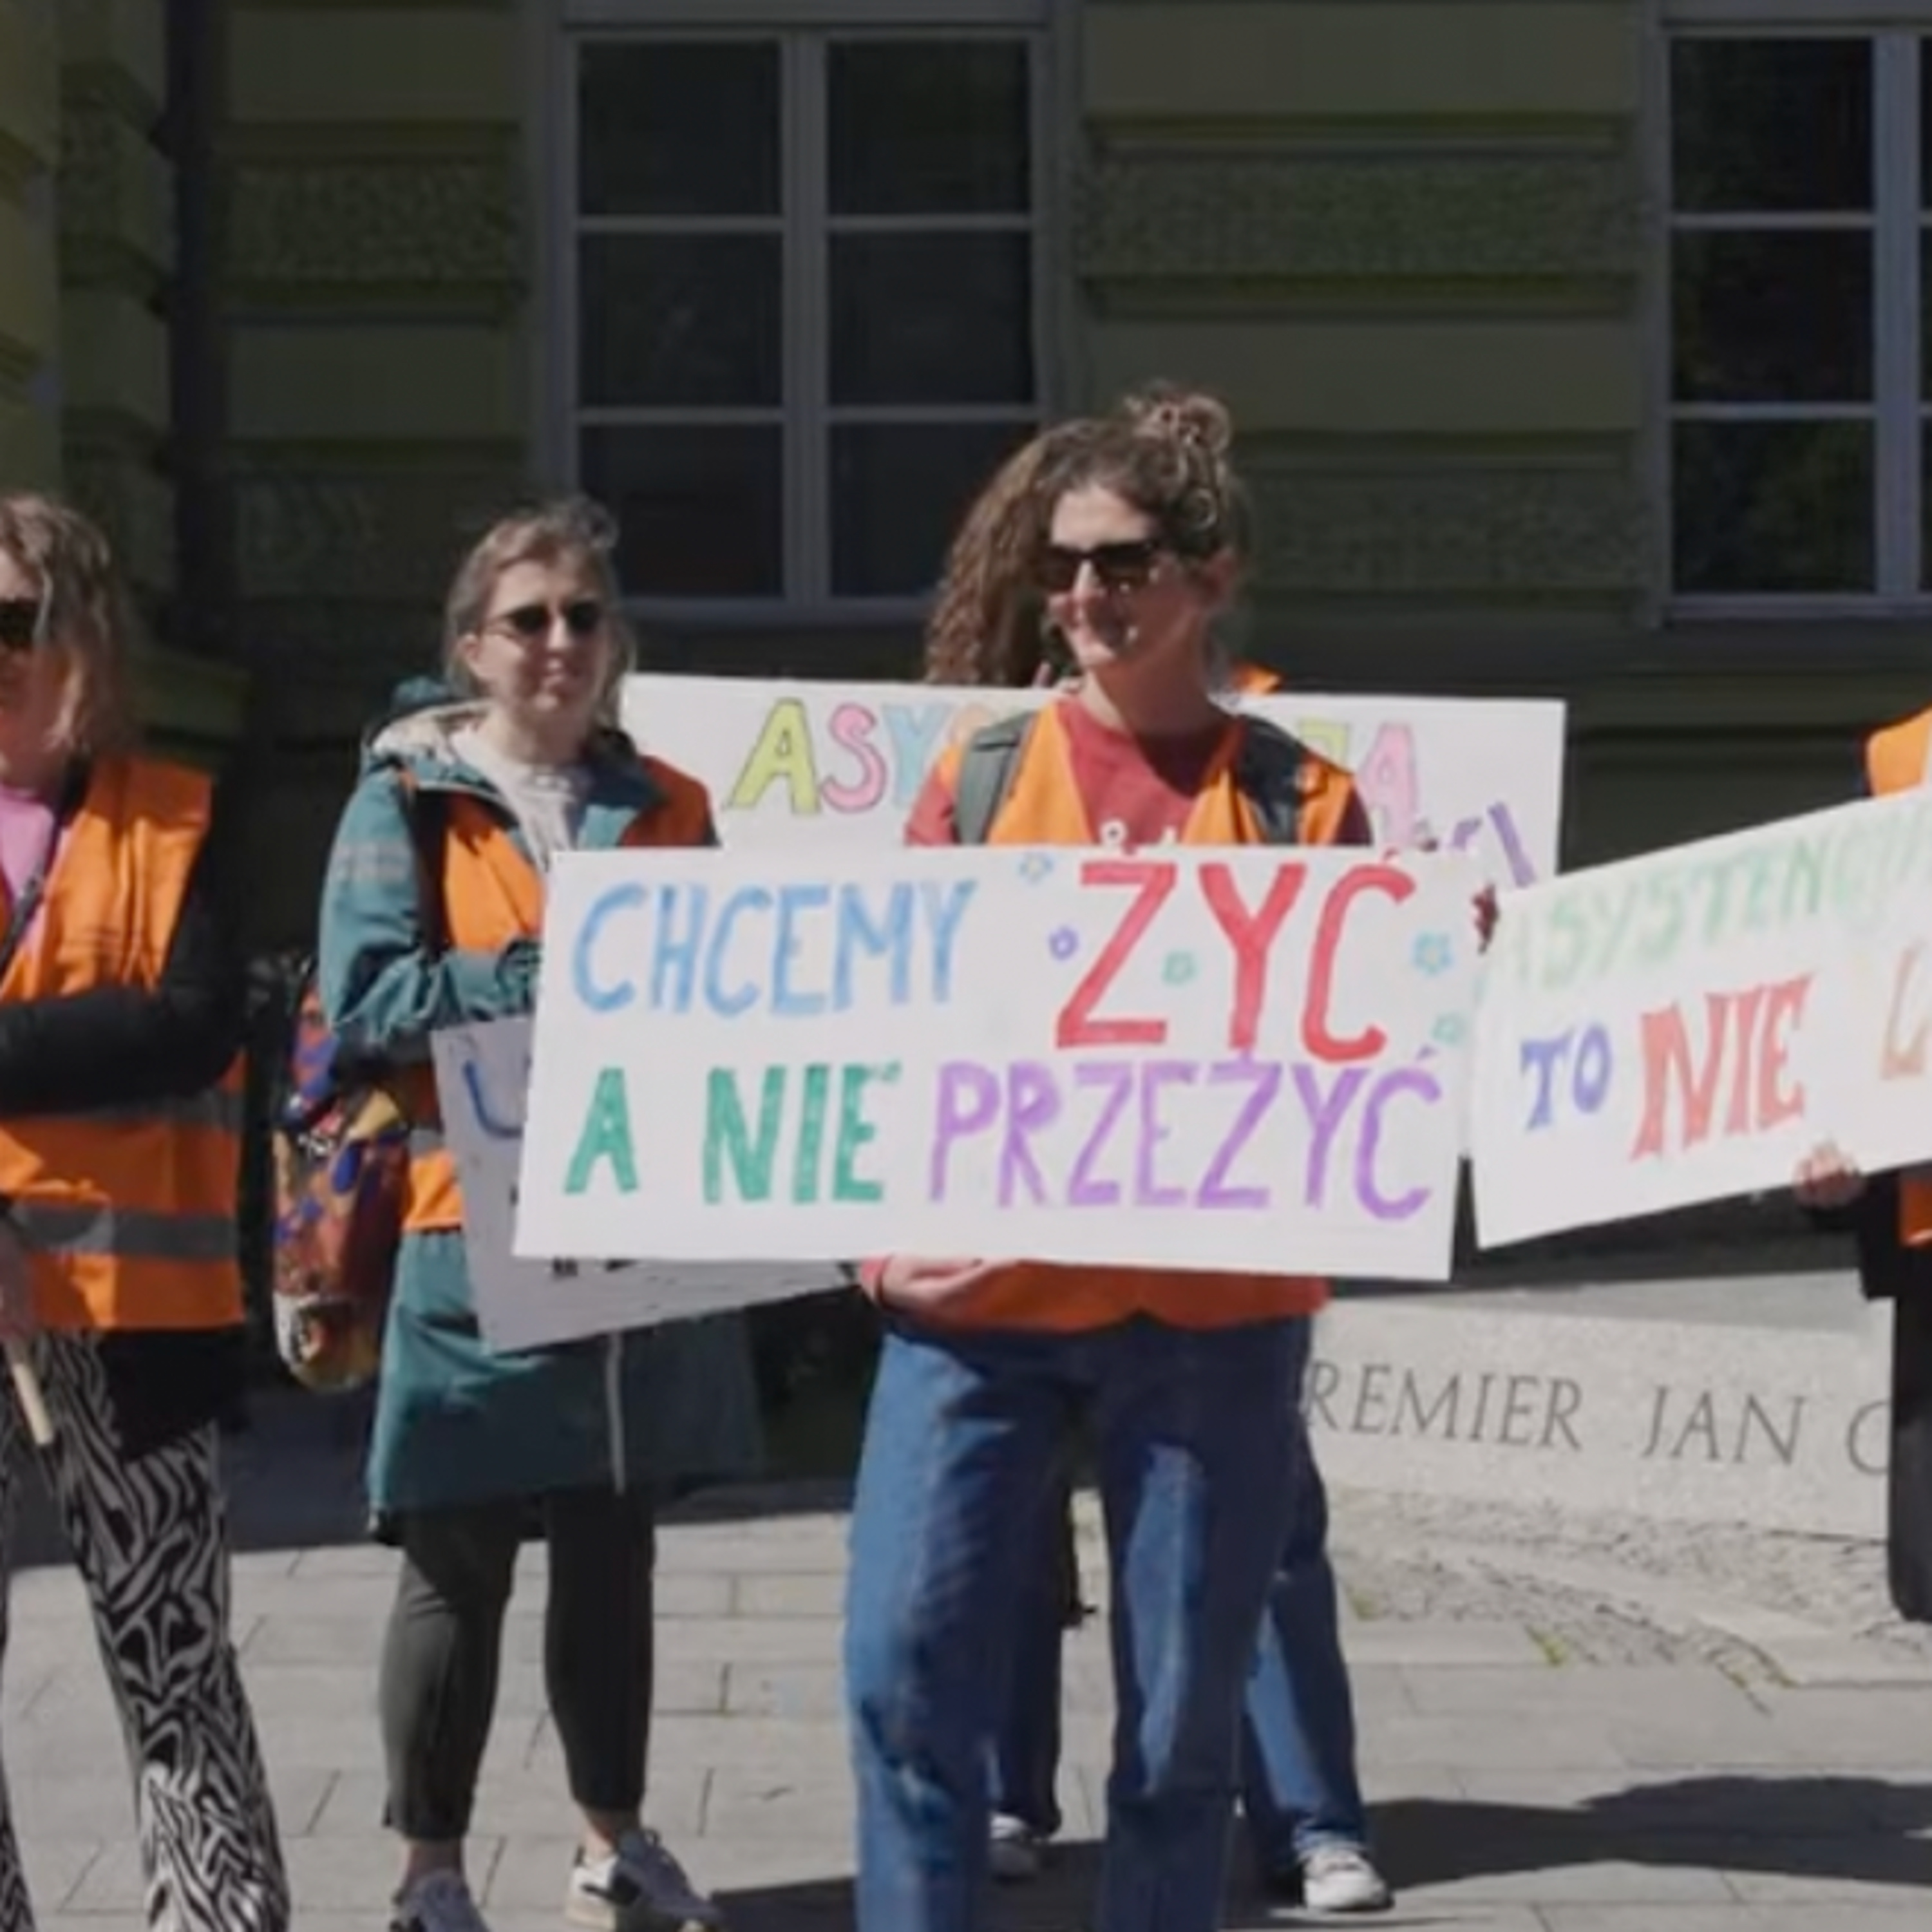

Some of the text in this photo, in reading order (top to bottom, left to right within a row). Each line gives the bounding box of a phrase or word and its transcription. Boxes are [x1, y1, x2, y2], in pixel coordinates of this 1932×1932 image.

[571, 846, 1416, 1064] CHCEMY ŻYĆ
[563, 1065, 640, 1195] A
[702, 1061, 902, 1206] NIE
[929, 1045, 1443, 1220] PRZEŻYĆ
[1520, 1019, 1613, 1133] TO
[1628, 970, 1815, 1164] NIE
[1305, 1359, 1584, 1453] REMIER
[1641, 1384, 1810, 1467] JAN
